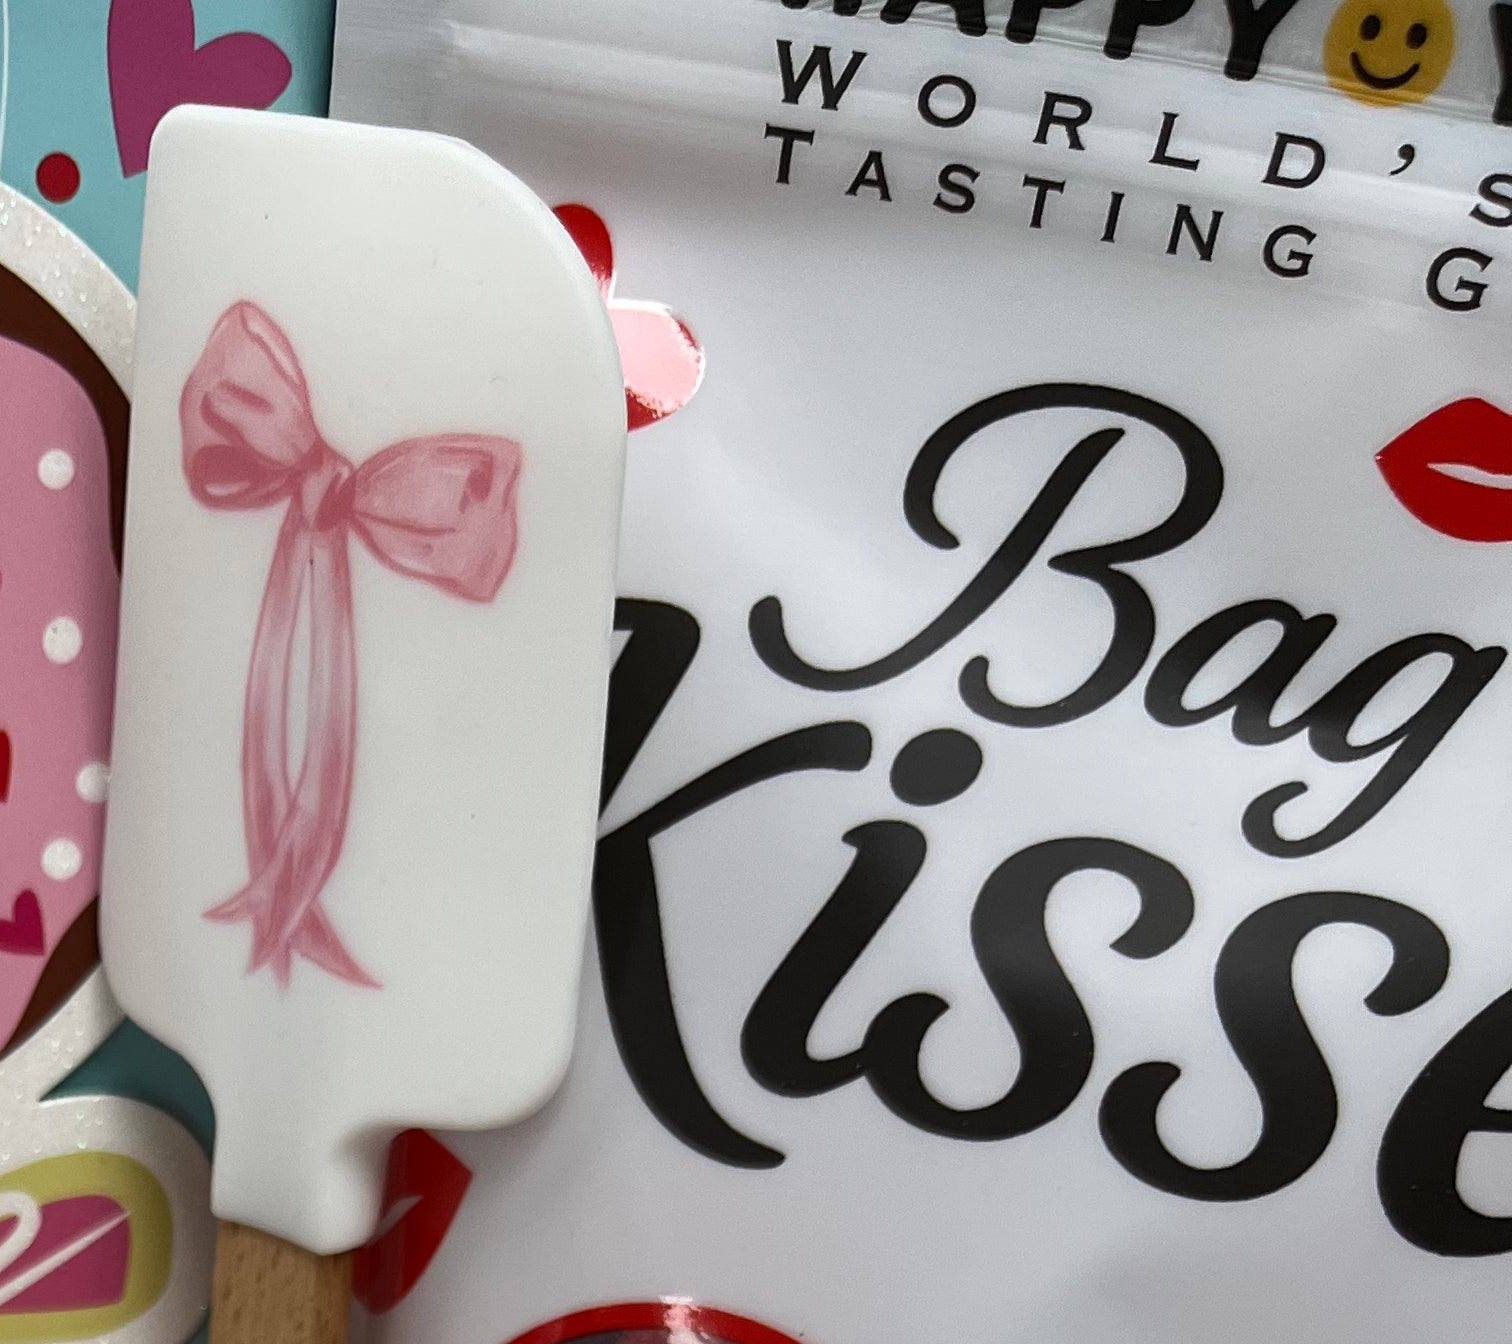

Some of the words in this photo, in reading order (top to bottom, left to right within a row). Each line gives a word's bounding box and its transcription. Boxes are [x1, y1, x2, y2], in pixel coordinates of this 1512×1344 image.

[778, 0, 1288, 82] PPY
[763, 123, 1316, 279] TASTING
[774, 38, 1512, 228] WORLD'S
[748, 382, 1508, 858] Bag
